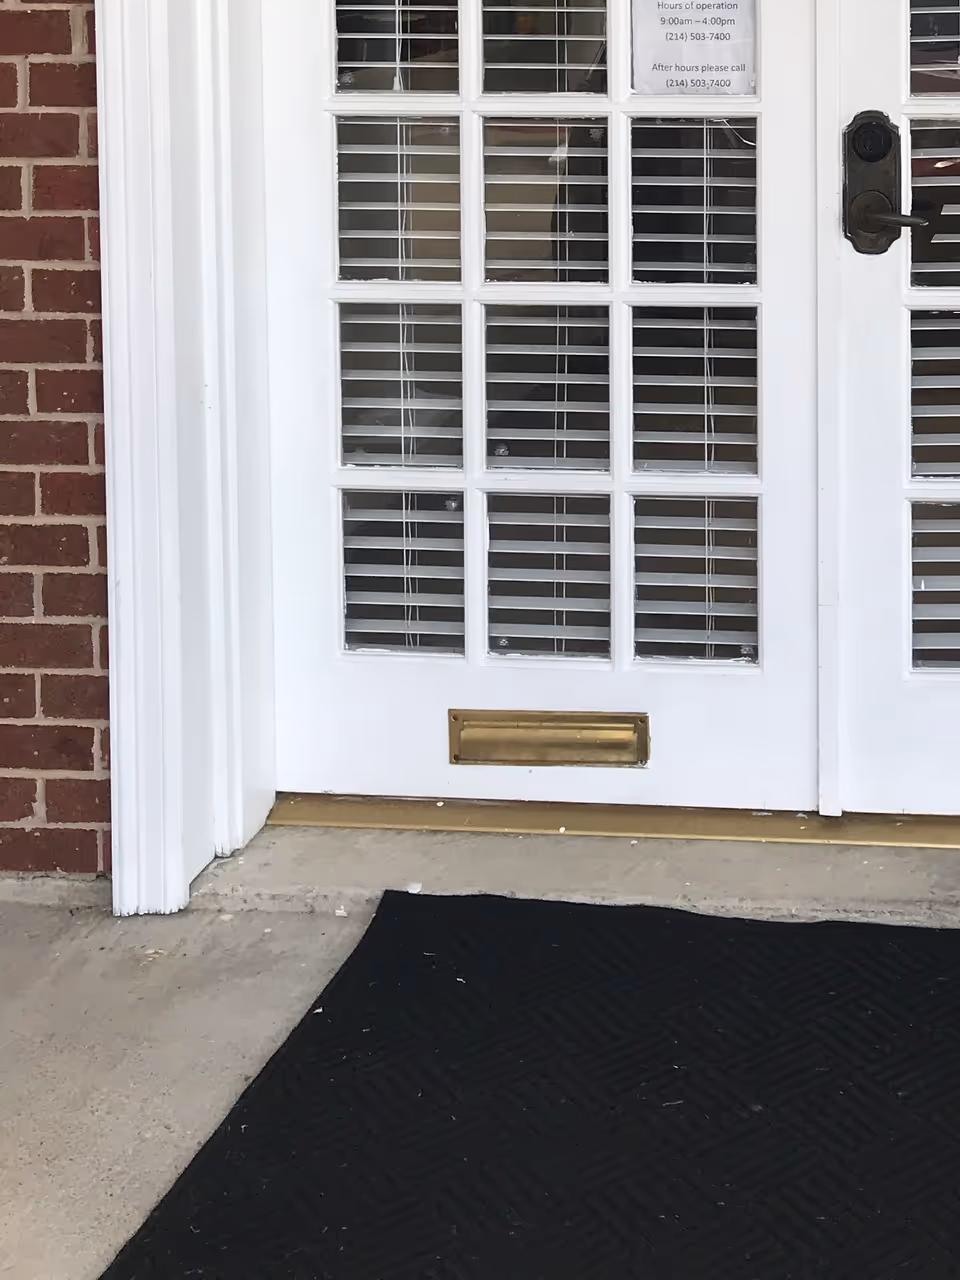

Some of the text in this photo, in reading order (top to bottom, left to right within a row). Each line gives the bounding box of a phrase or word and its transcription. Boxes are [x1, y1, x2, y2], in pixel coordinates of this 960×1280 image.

[685, 1, 694, 9] of
[696, 2, 738, 12] operation
[660, 17, 692, 25] 9:00am
[702, 17, 735, 27] 4:00pm
[666, 33, 688, 42] (214)
[652, 63, 673, 71] After
[675, 64, 699, 72] hours
[701, 64, 729, 74] please
[666, 79, 731, 89] (214) 503-7400
